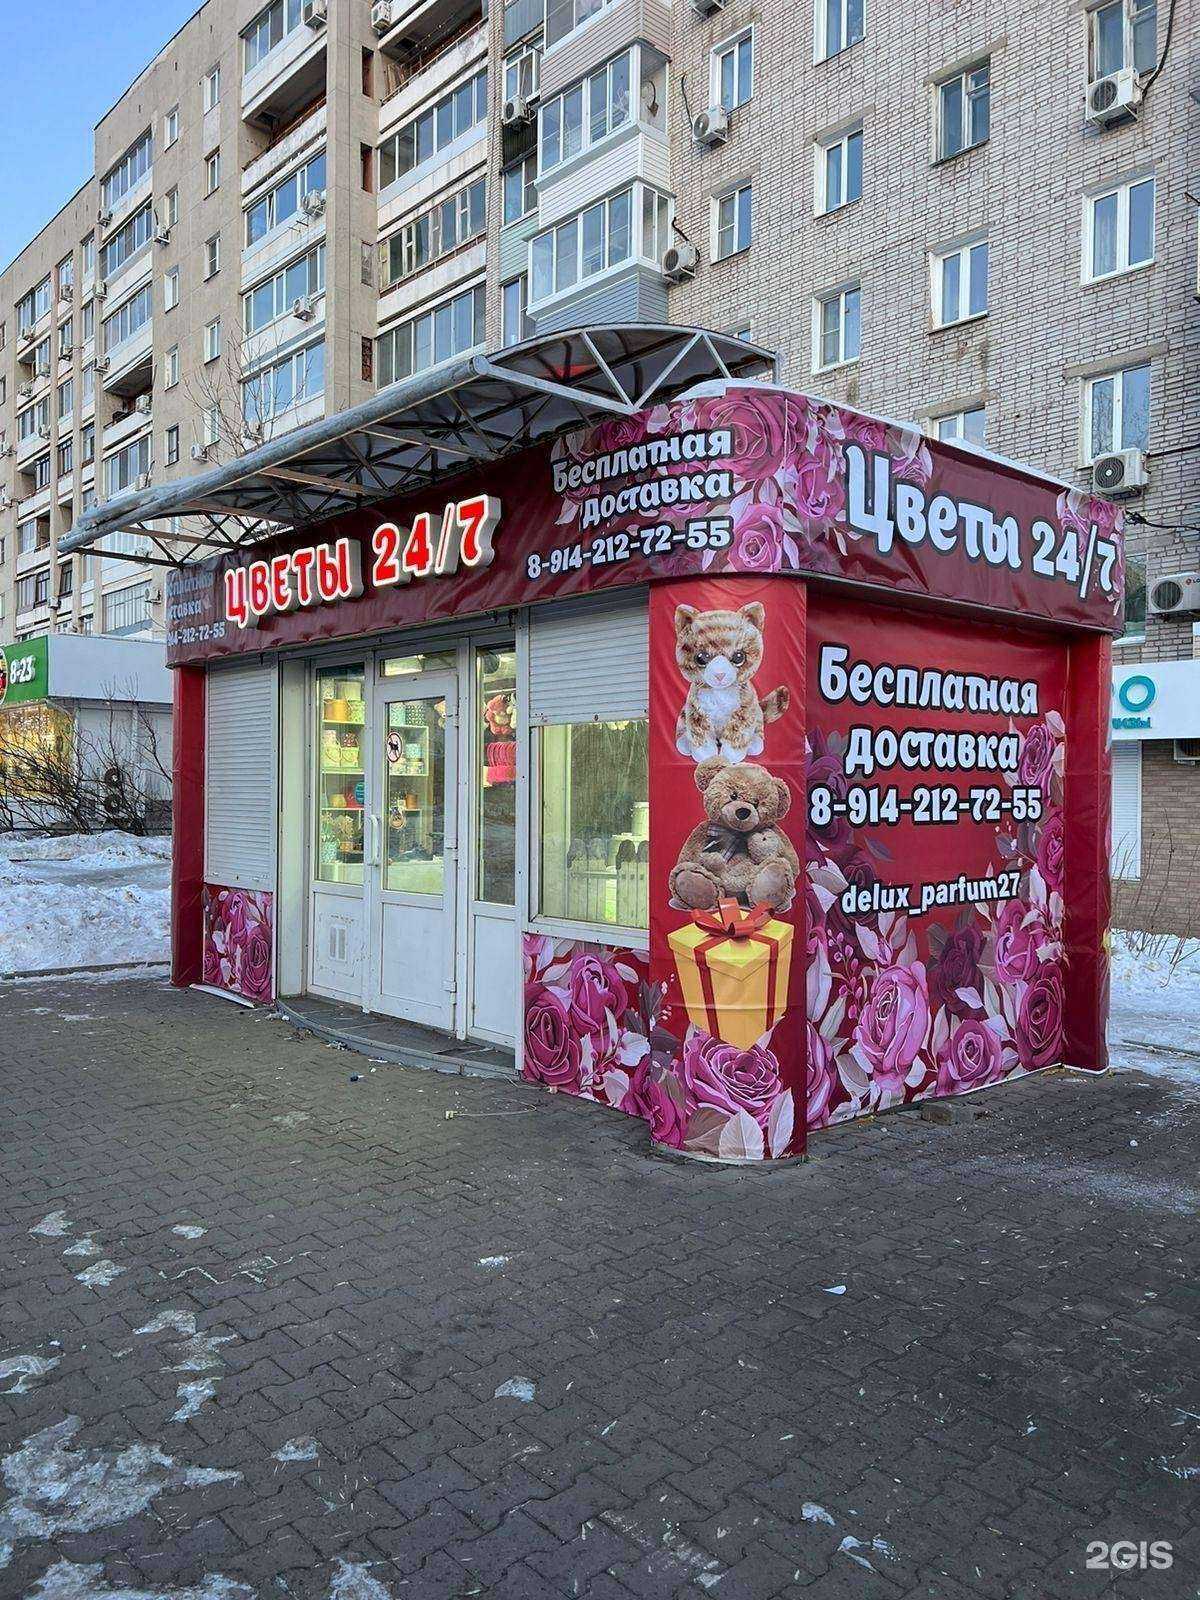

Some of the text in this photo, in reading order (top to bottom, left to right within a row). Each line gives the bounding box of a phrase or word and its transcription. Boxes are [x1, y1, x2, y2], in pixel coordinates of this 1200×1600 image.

[551, 429, 732, 492] Бесплатная
[526, 520, 733, 579] 8-914-212-72-55
[846, 445, 1117, 600] Цветы 24/7
[224, 493, 492, 629] ЦВЕТЫ 24/7
[10, 655, 36, 684] 8-23
[819, 645, 1039, 716] Бесплатная
[810, 787, 1041, 825] 8-914-212-72-55
[841, 871, 1020, 915] delux_parfum27
